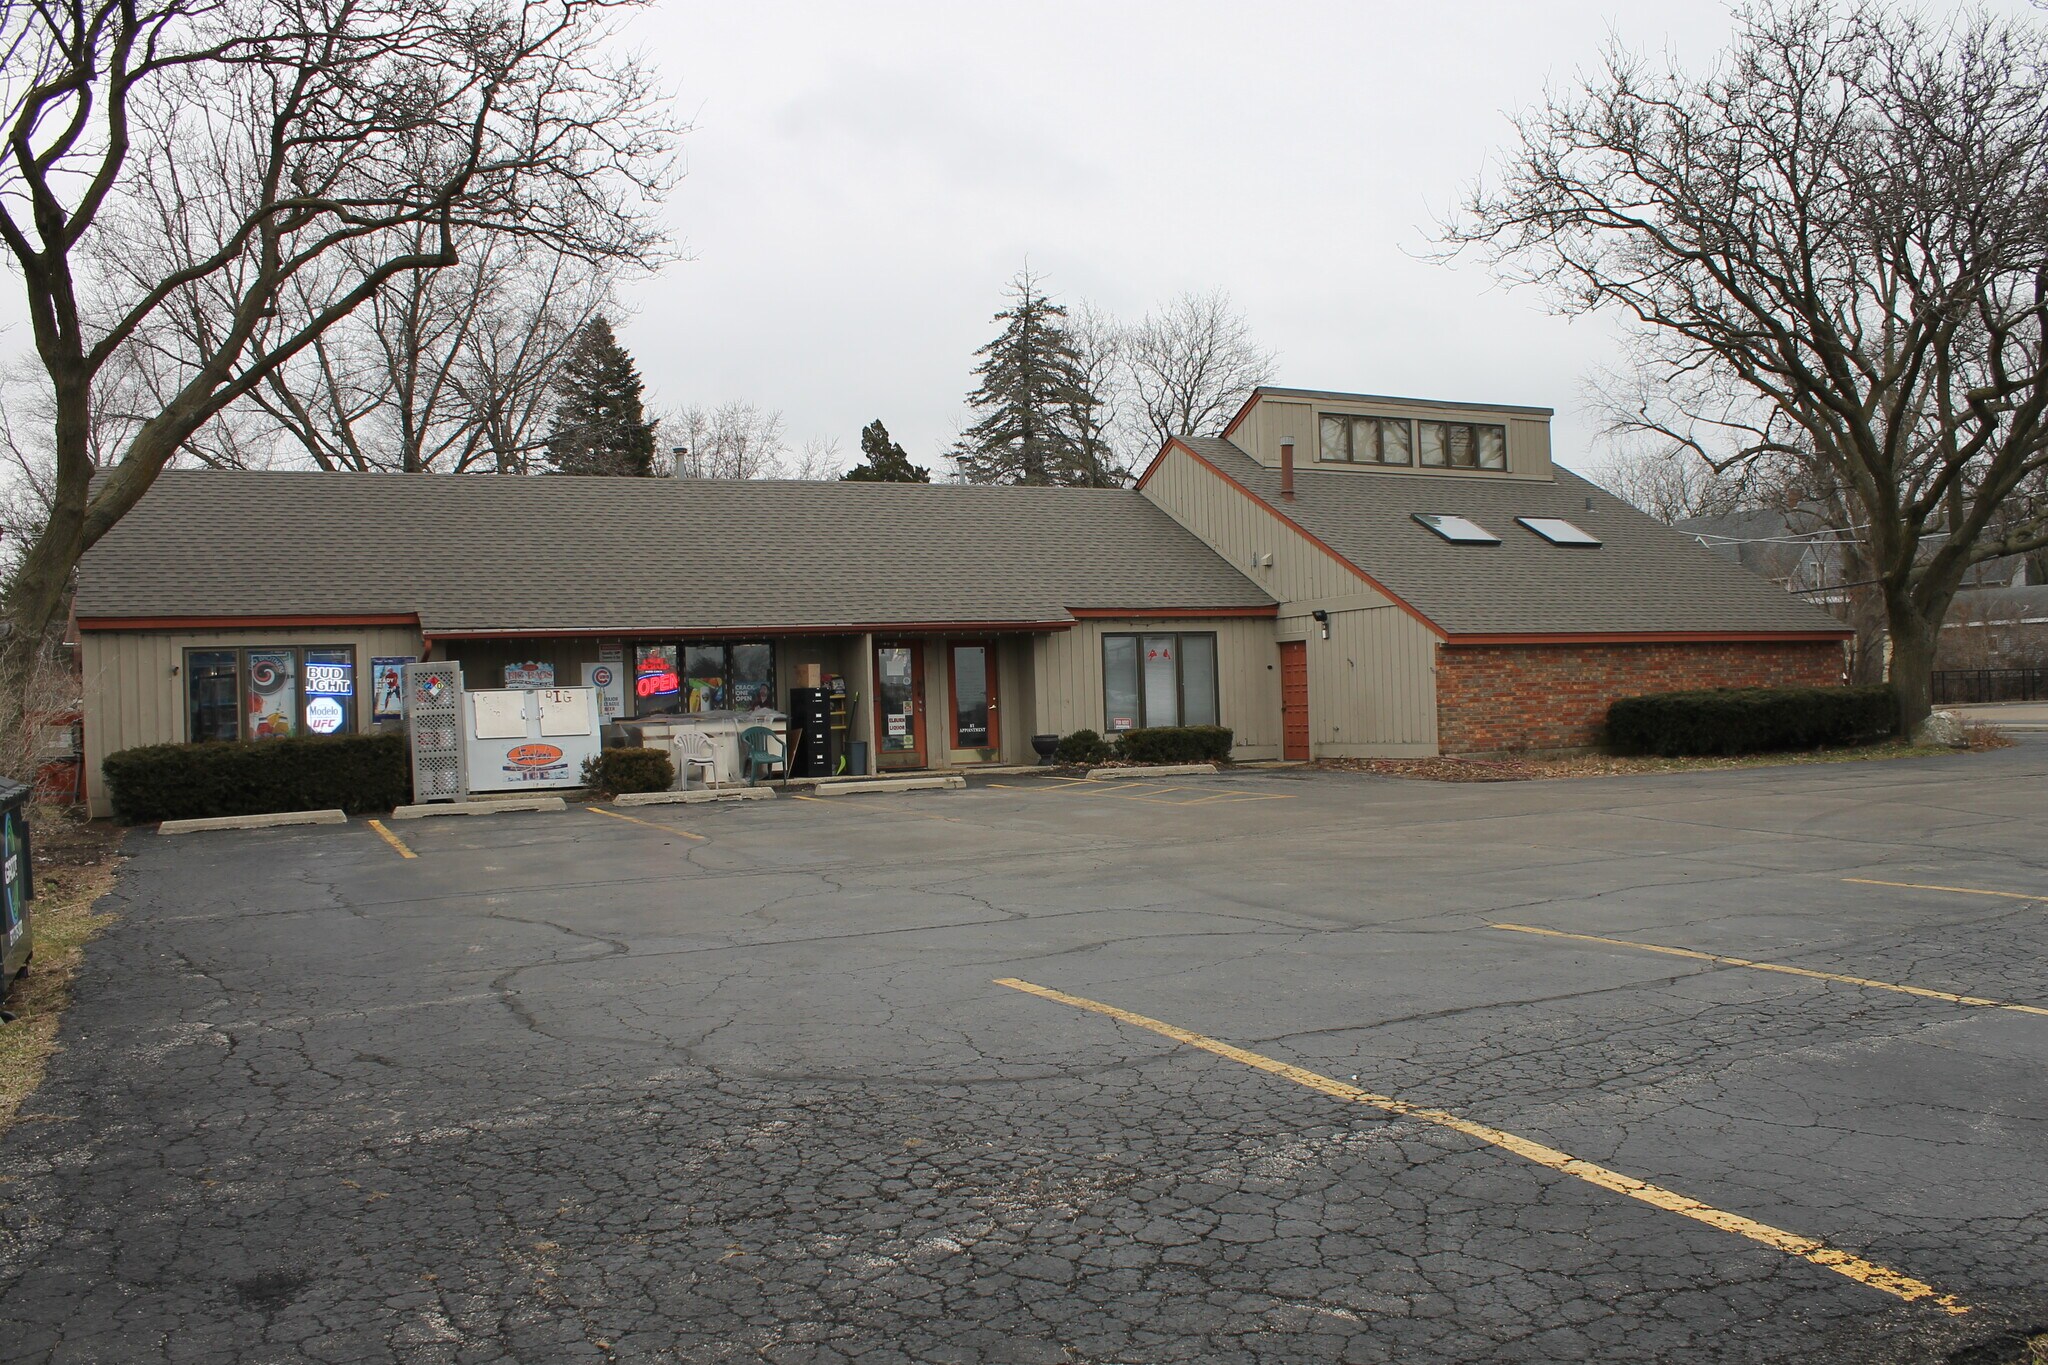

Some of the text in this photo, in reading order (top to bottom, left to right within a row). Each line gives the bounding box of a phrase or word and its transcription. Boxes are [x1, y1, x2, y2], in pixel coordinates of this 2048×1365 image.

[307, 666, 344, 679] BUD
[637, 672, 678, 696] OPEN
[310, 706, 338, 716] Modelo
[312, 719, 335, 728] UFC
